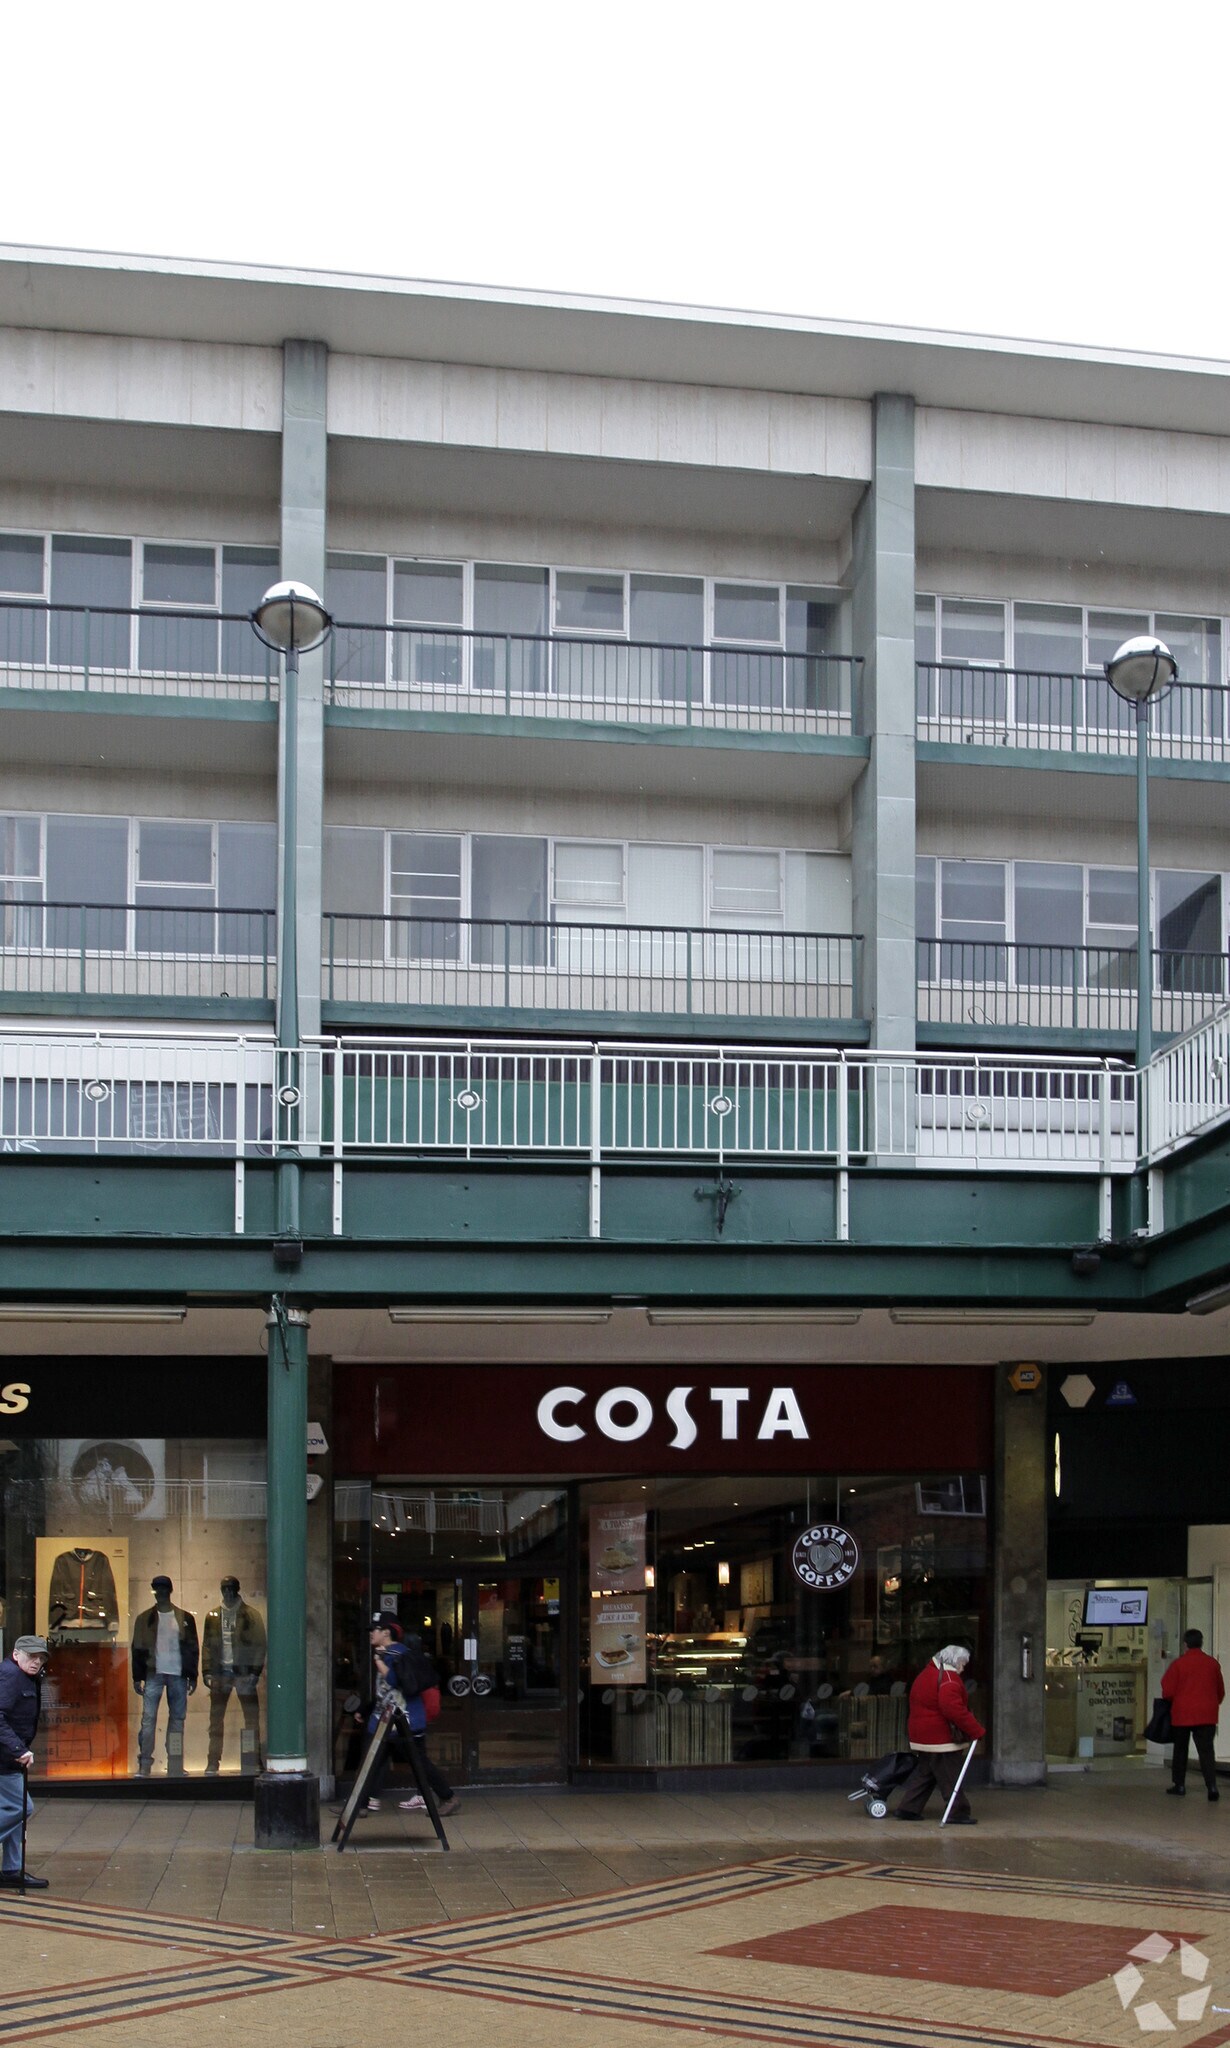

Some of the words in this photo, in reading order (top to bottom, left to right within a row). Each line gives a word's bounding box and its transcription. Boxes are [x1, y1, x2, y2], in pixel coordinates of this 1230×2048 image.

[537, 1386, 810, 1450] COSTA
[802, 1527, 847, 1546] COSTA
[798, 1562, 853, 1586] COFFEE
[1086, 1680, 1099, 1689] Try
[1101, 1680, 1117, 1688] the
[1088, 1697, 1126, 1706] gadgets
